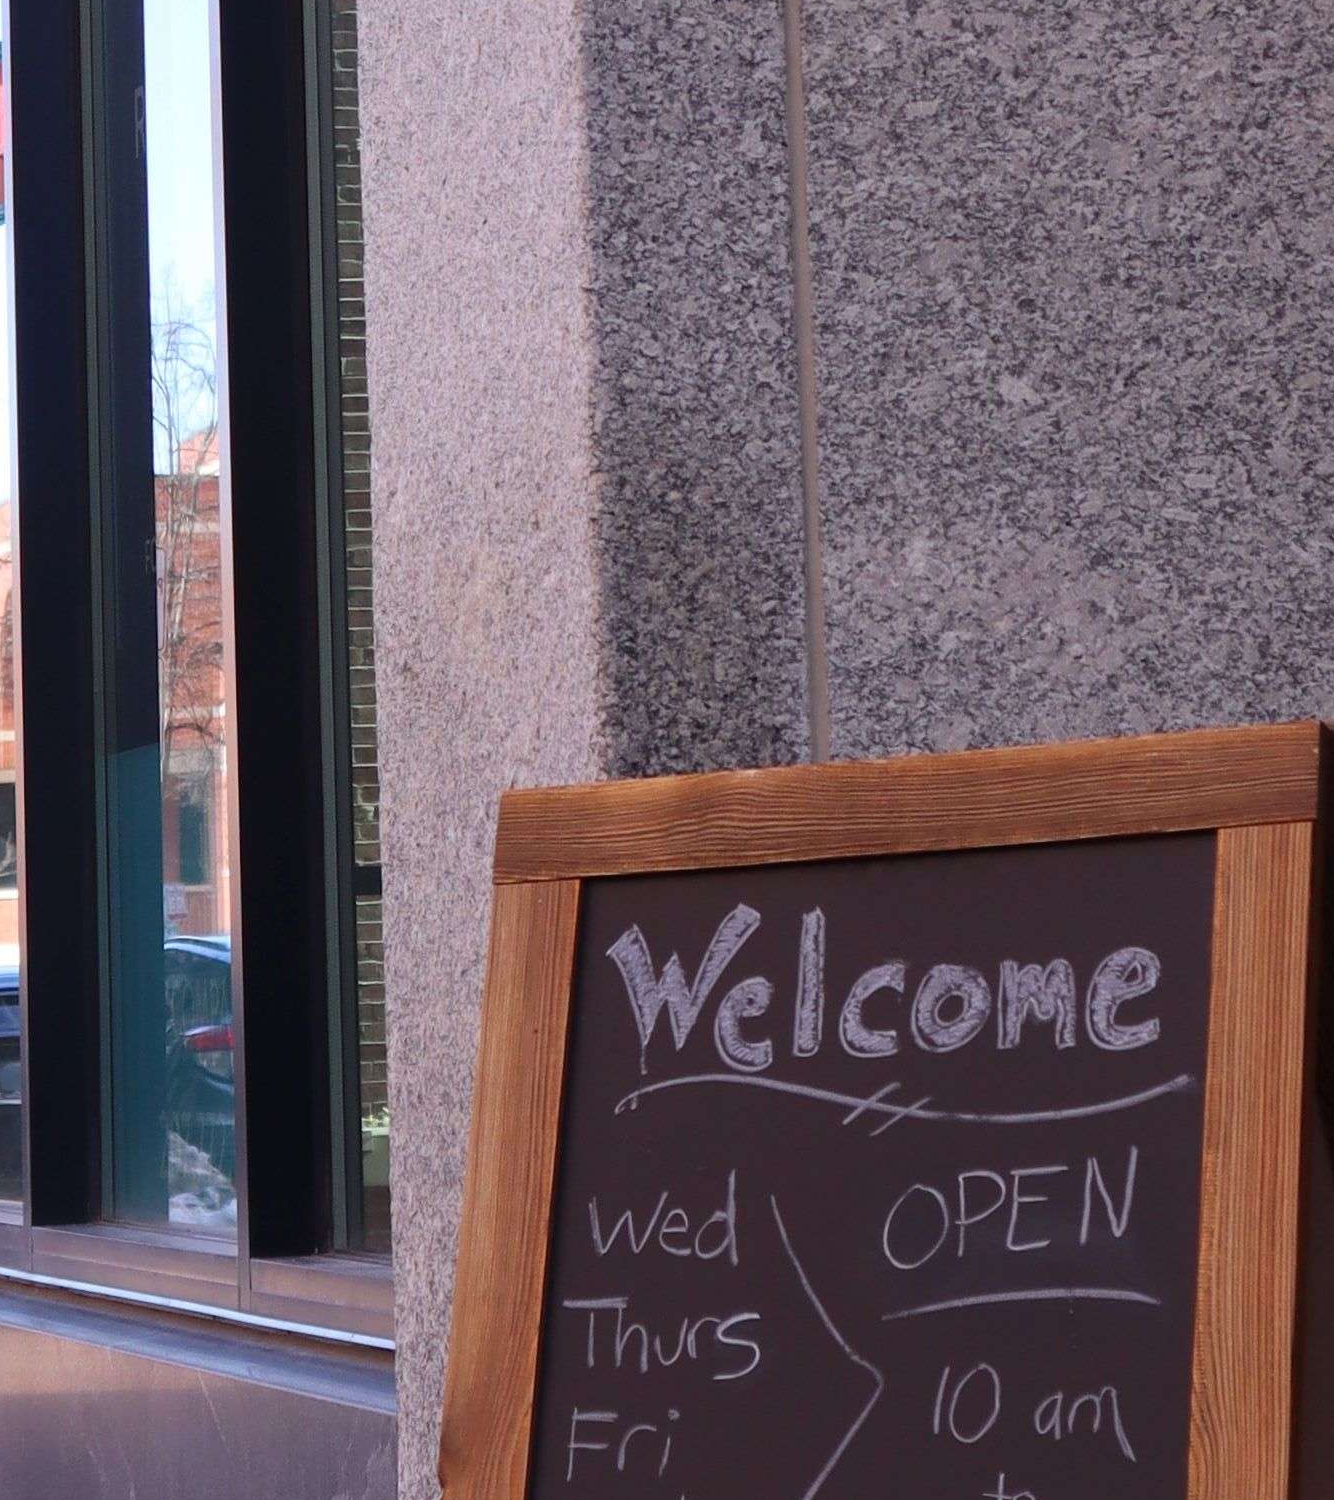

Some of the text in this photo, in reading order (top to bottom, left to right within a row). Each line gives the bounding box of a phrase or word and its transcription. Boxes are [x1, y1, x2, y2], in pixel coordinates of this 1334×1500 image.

[605, 902, 1161, 1073] Welcome
[588, 1169, 739, 1266] Wed
[882, 1146, 1138, 1270] OPEN
[563, 1297, 761, 1381] Thurs
[567, 1407, 681, 1482] Fri
[933, 1363, 1137, 1462] 10 am
